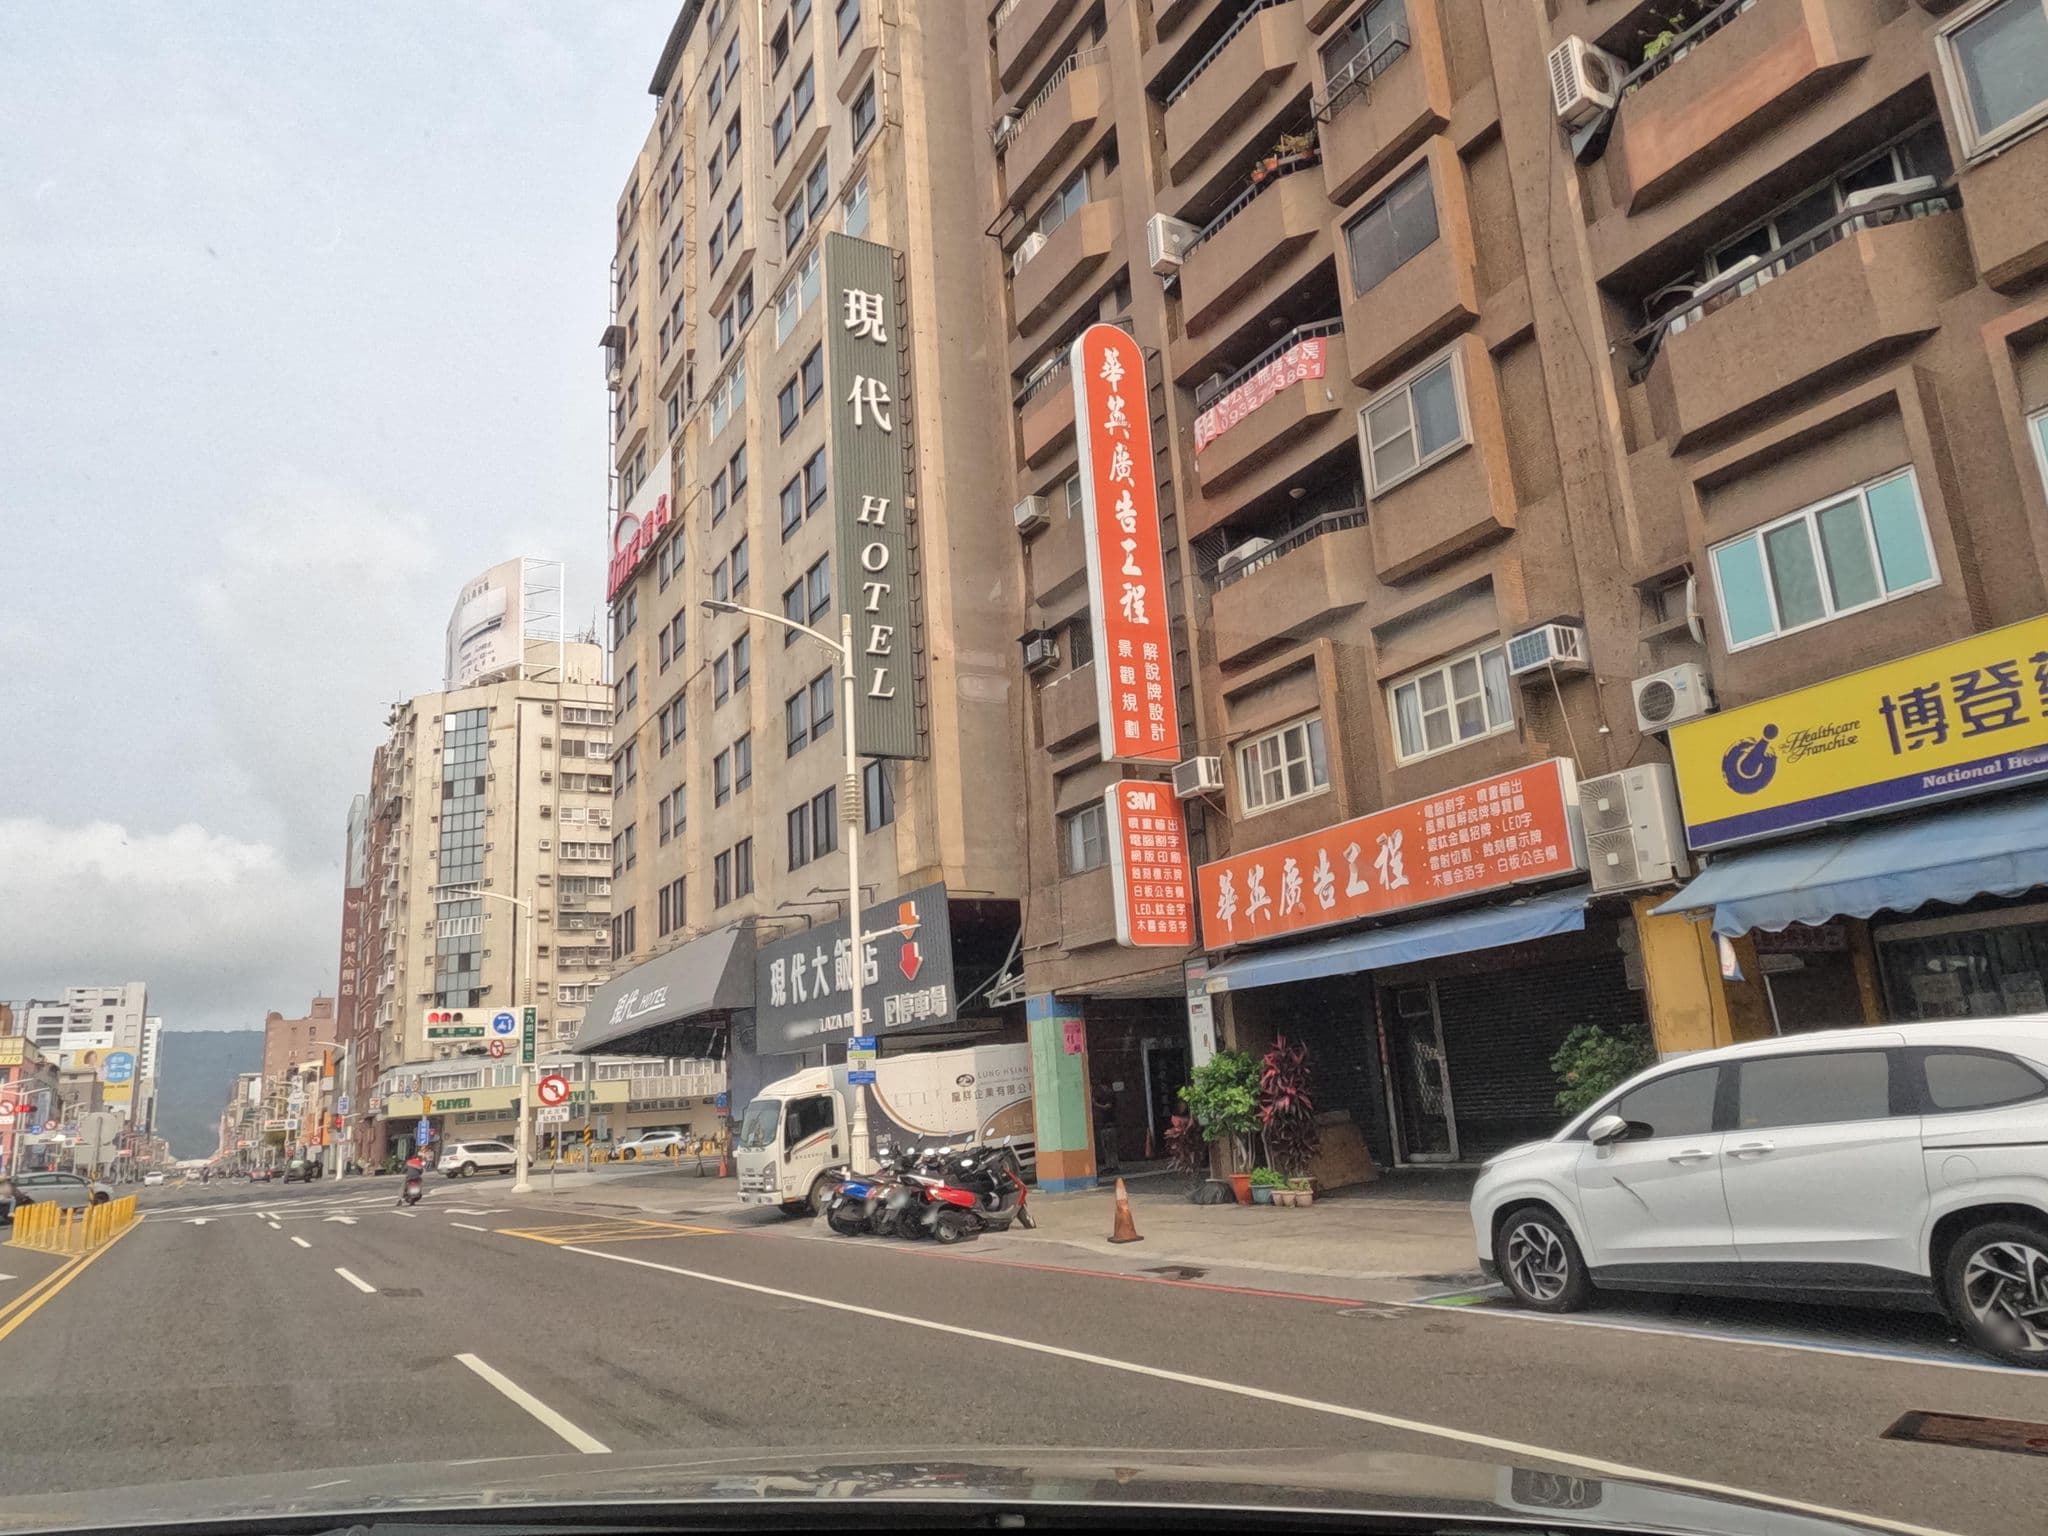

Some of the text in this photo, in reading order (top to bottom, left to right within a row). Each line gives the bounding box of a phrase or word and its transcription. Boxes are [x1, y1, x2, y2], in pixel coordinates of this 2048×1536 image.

[842, 287, 896, 699] 現代 HOTEL
[1786, 720, 1861, 752] Healthcare
[1786, 735, 1858, 764] Franchise
[1922, 760, 2002, 789] National
[1126, 791, 1157, 811] 3M
[1133, 885, 1185, 898] 白板公告欄
[1003, 1066, 1030, 1077] HSIAN
